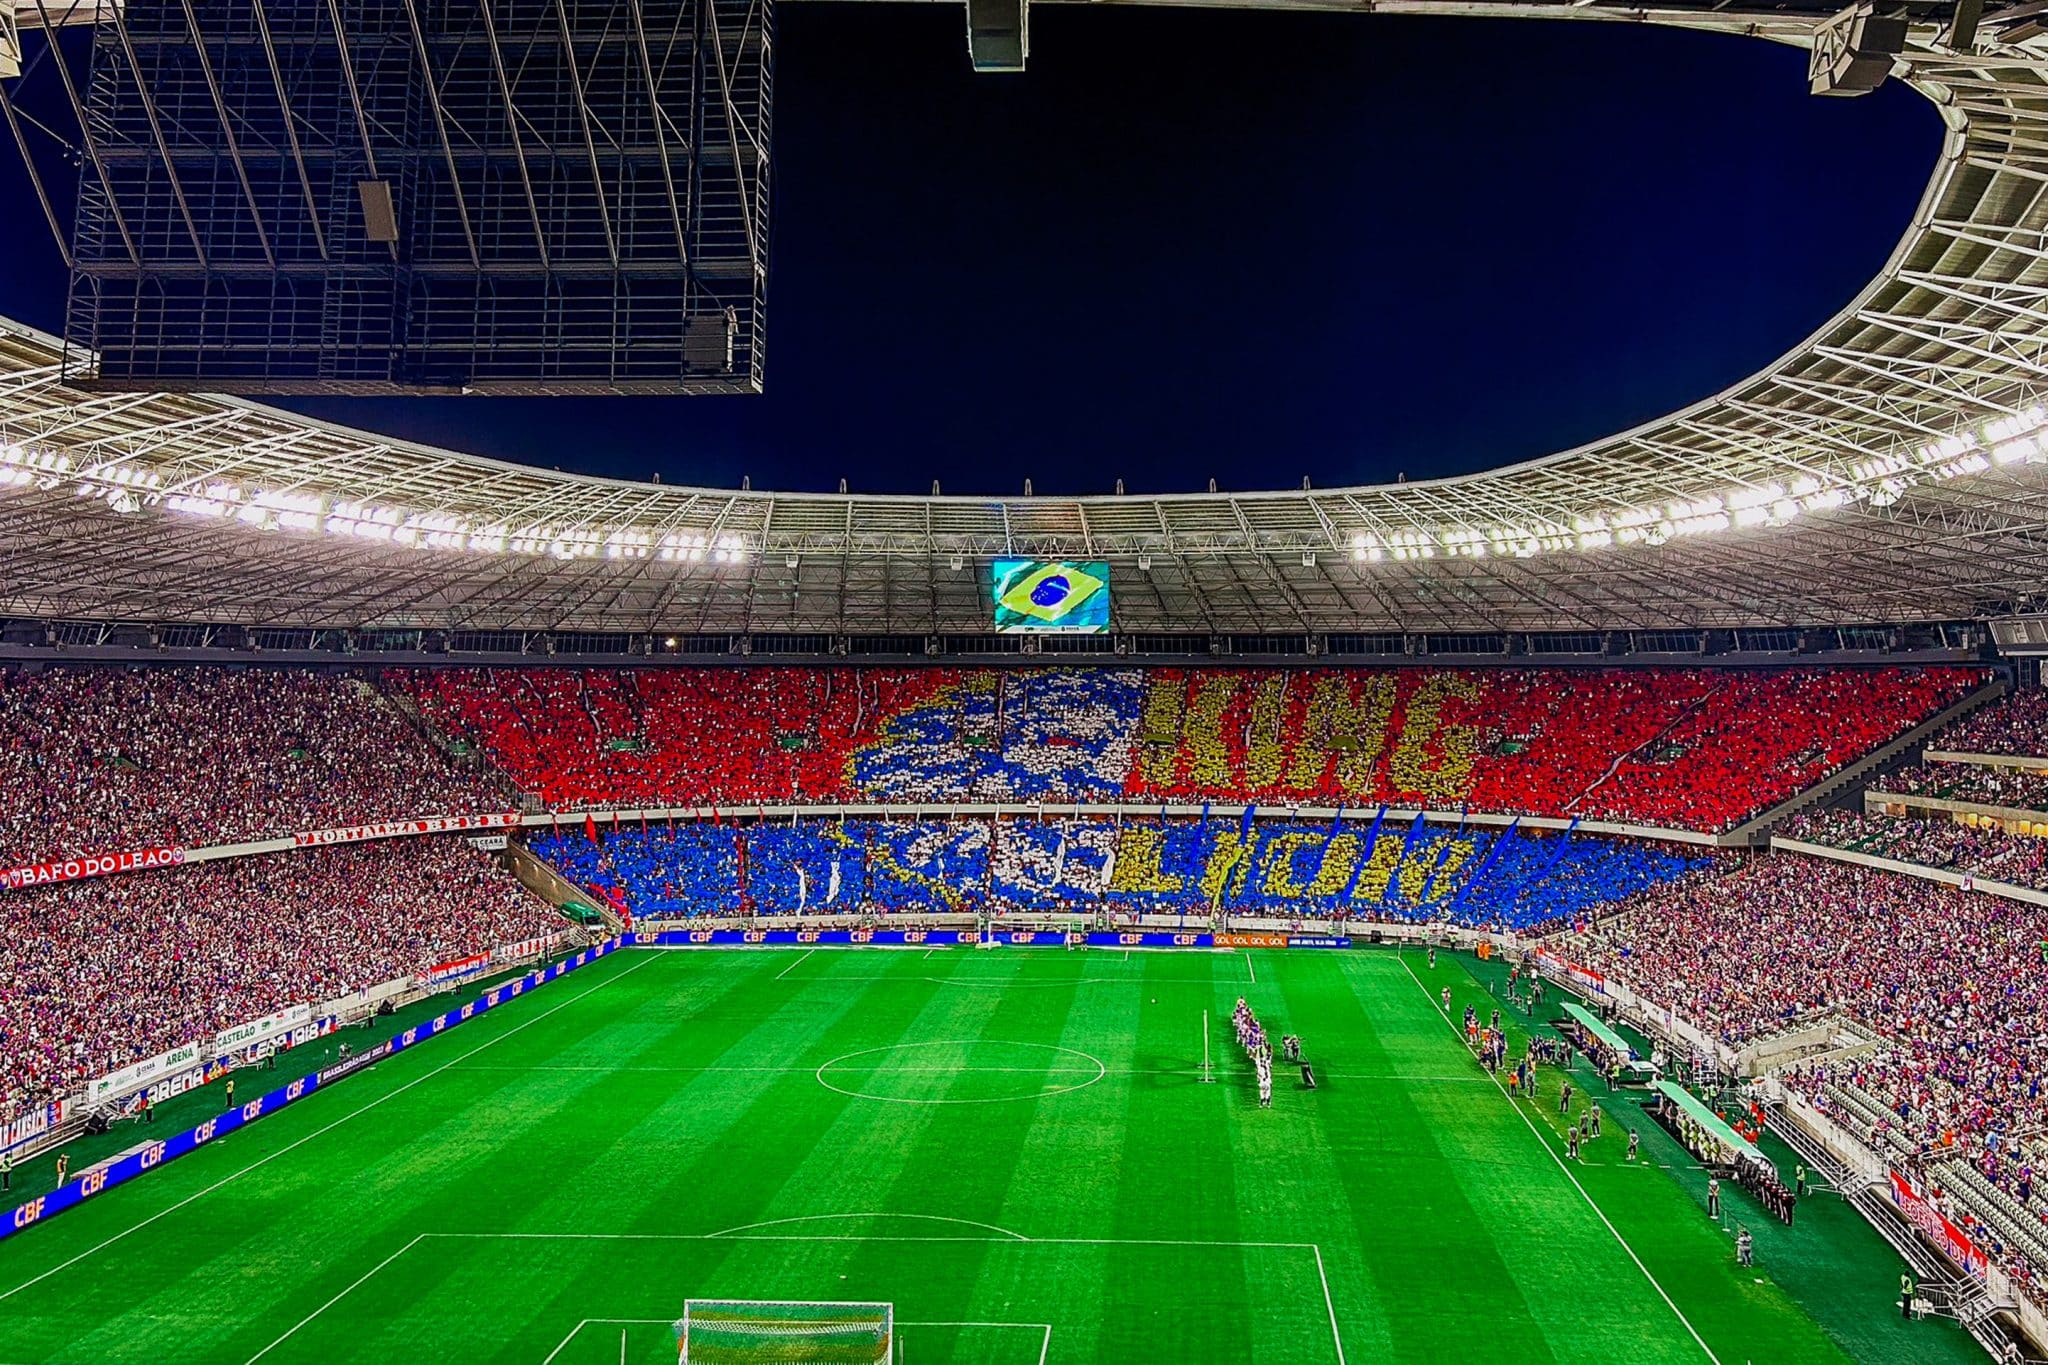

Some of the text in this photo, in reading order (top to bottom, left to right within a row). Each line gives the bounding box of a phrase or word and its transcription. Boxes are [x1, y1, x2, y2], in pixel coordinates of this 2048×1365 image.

[313, 821, 425, 842] FORTALEZA
[21, 861, 80, 884] BAFO
[86, 857, 116, 876] DO
[634, 933, 658, 943] CBF
[690, 932, 714, 943] CBF
[743, 932, 767, 943] CBF
[797, 932, 821, 943] CBF
[850, 932, 874, 943] CBF
[904, 932, 927, 943] CBF
[1011, 932, 1035, 943] CBF
[1119, 933, 1143, 944] CBF
[1173, 934, 1197, 945] CBF
[1215, 936, 1230, 945] GOL
[1233, 936, 1248, 945] GOL
[1251, 937, 1266, 946] GOL
[1268, 937, 1284, 946] GOL
[402, 1027, 416, 1046] CBF
[432, 1014, 447, 1033] CBF
[461, 1002, 474, 1019] CBF
[487, 990, 499, 1006] CBF
[512, 980, 524, 996] CBF
[535, 970, 546, 985] CBF
[292, 1022, 319, 1048] 1918
[165, 1047, 194, 1067] ARENA
[147, 1067, 204, 1103] ARENA
[14, 1078, 305, 1228] CBF CBF CBF CBF CBF CBF
